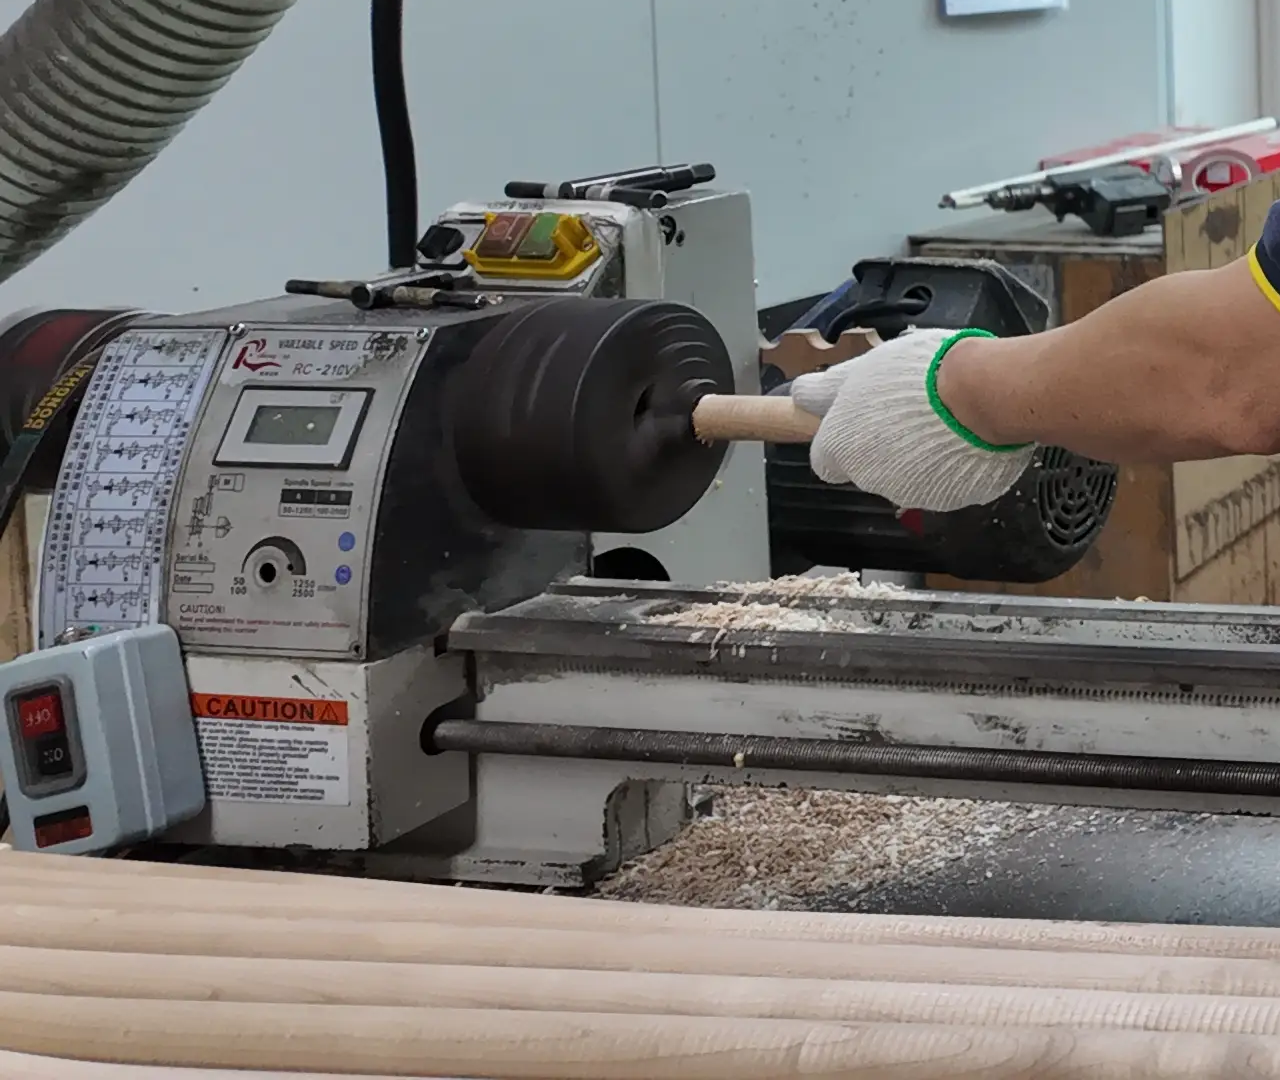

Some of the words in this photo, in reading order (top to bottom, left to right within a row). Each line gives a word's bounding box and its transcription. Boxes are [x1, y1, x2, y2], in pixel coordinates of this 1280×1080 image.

[278, 339, 324, 350] VARIABLE
[328, 339, 359, 350] SPEED
[233, 577, 245, 585] 50
[230, 587, 247, 595] 100
[291, 589, 315, 598] 2500
[206, 697, 315, 720] CAUTION
